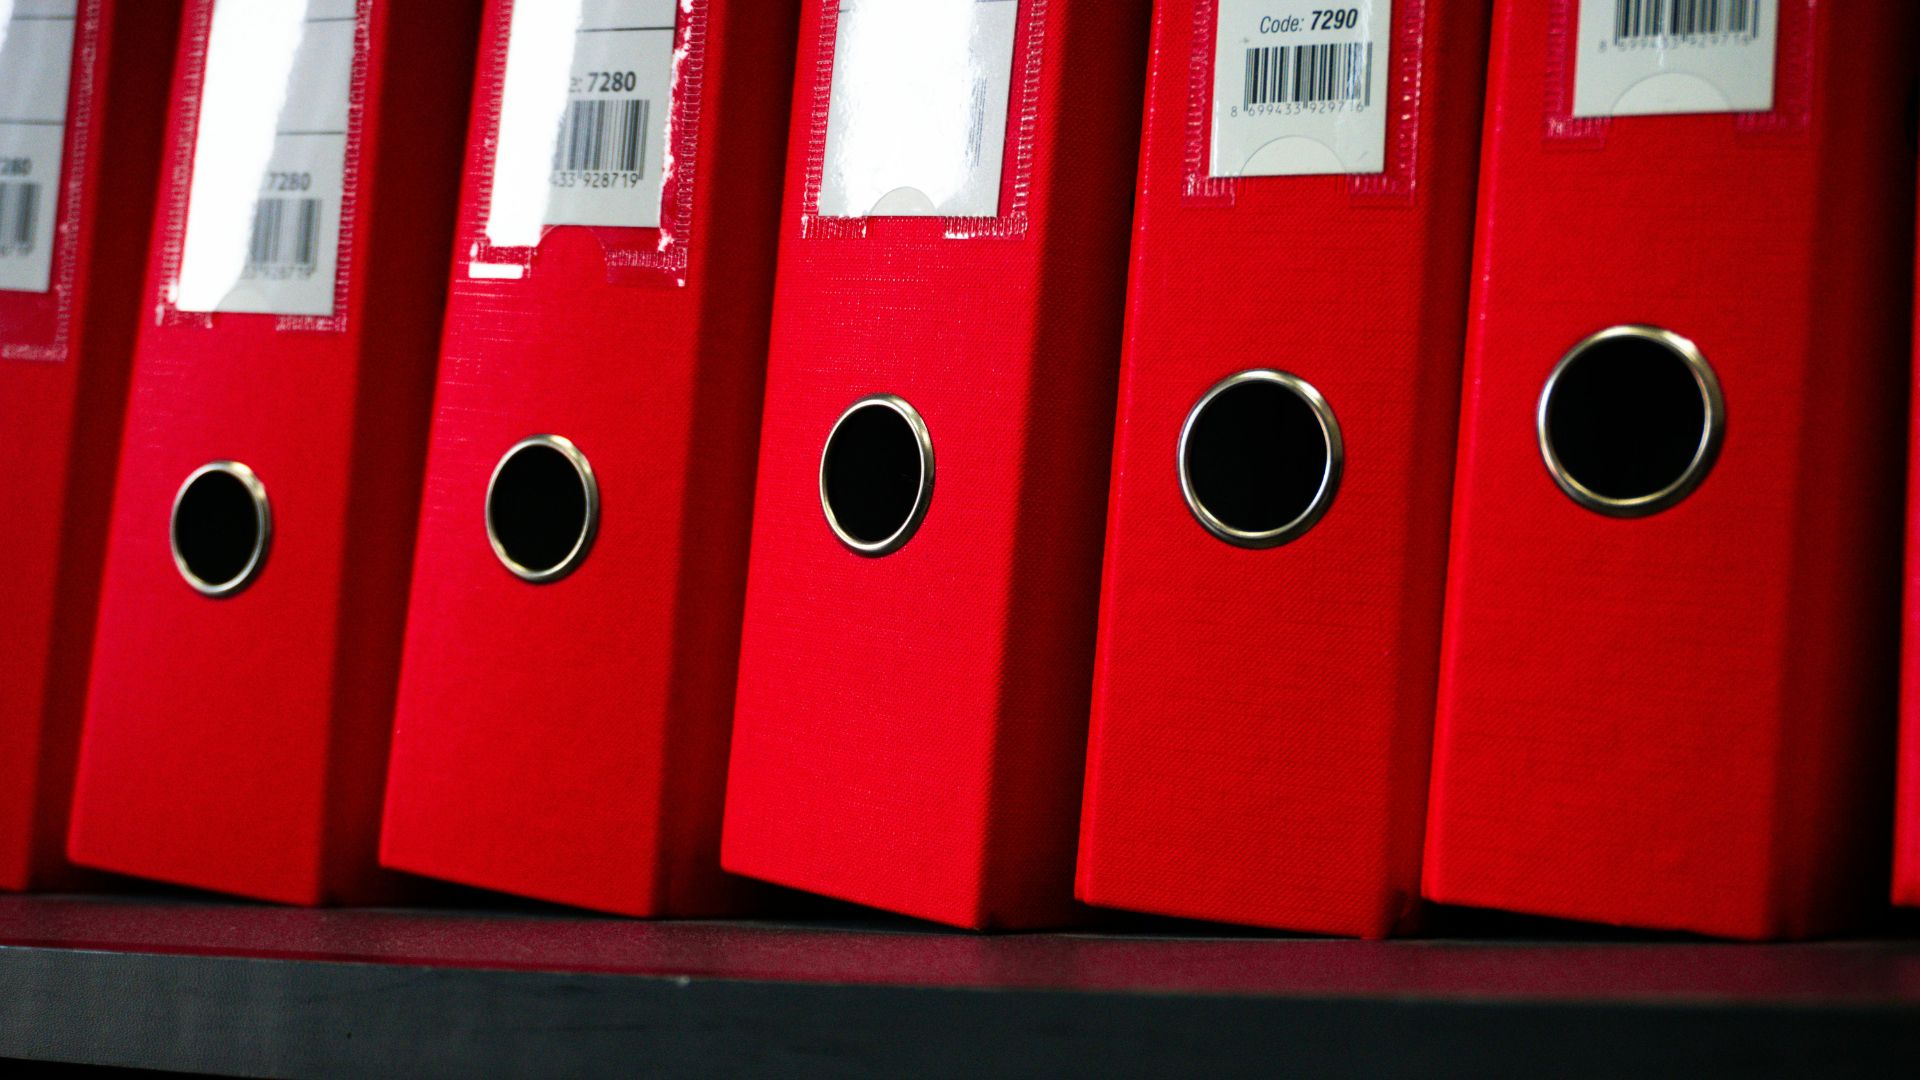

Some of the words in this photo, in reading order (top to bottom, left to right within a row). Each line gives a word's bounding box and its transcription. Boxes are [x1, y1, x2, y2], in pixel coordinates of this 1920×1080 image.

[1260, 15, 1305, 34] Code:
[1310, 8, 1359, 31] 7290
[587, 71, 637, 92] 7280
[1230, 105, 1238, 117] 8
[1248, 103, 1301, 117] 699433
[267, 172, 312, 191] 7280
[583, 172, 638, 188] 928719
